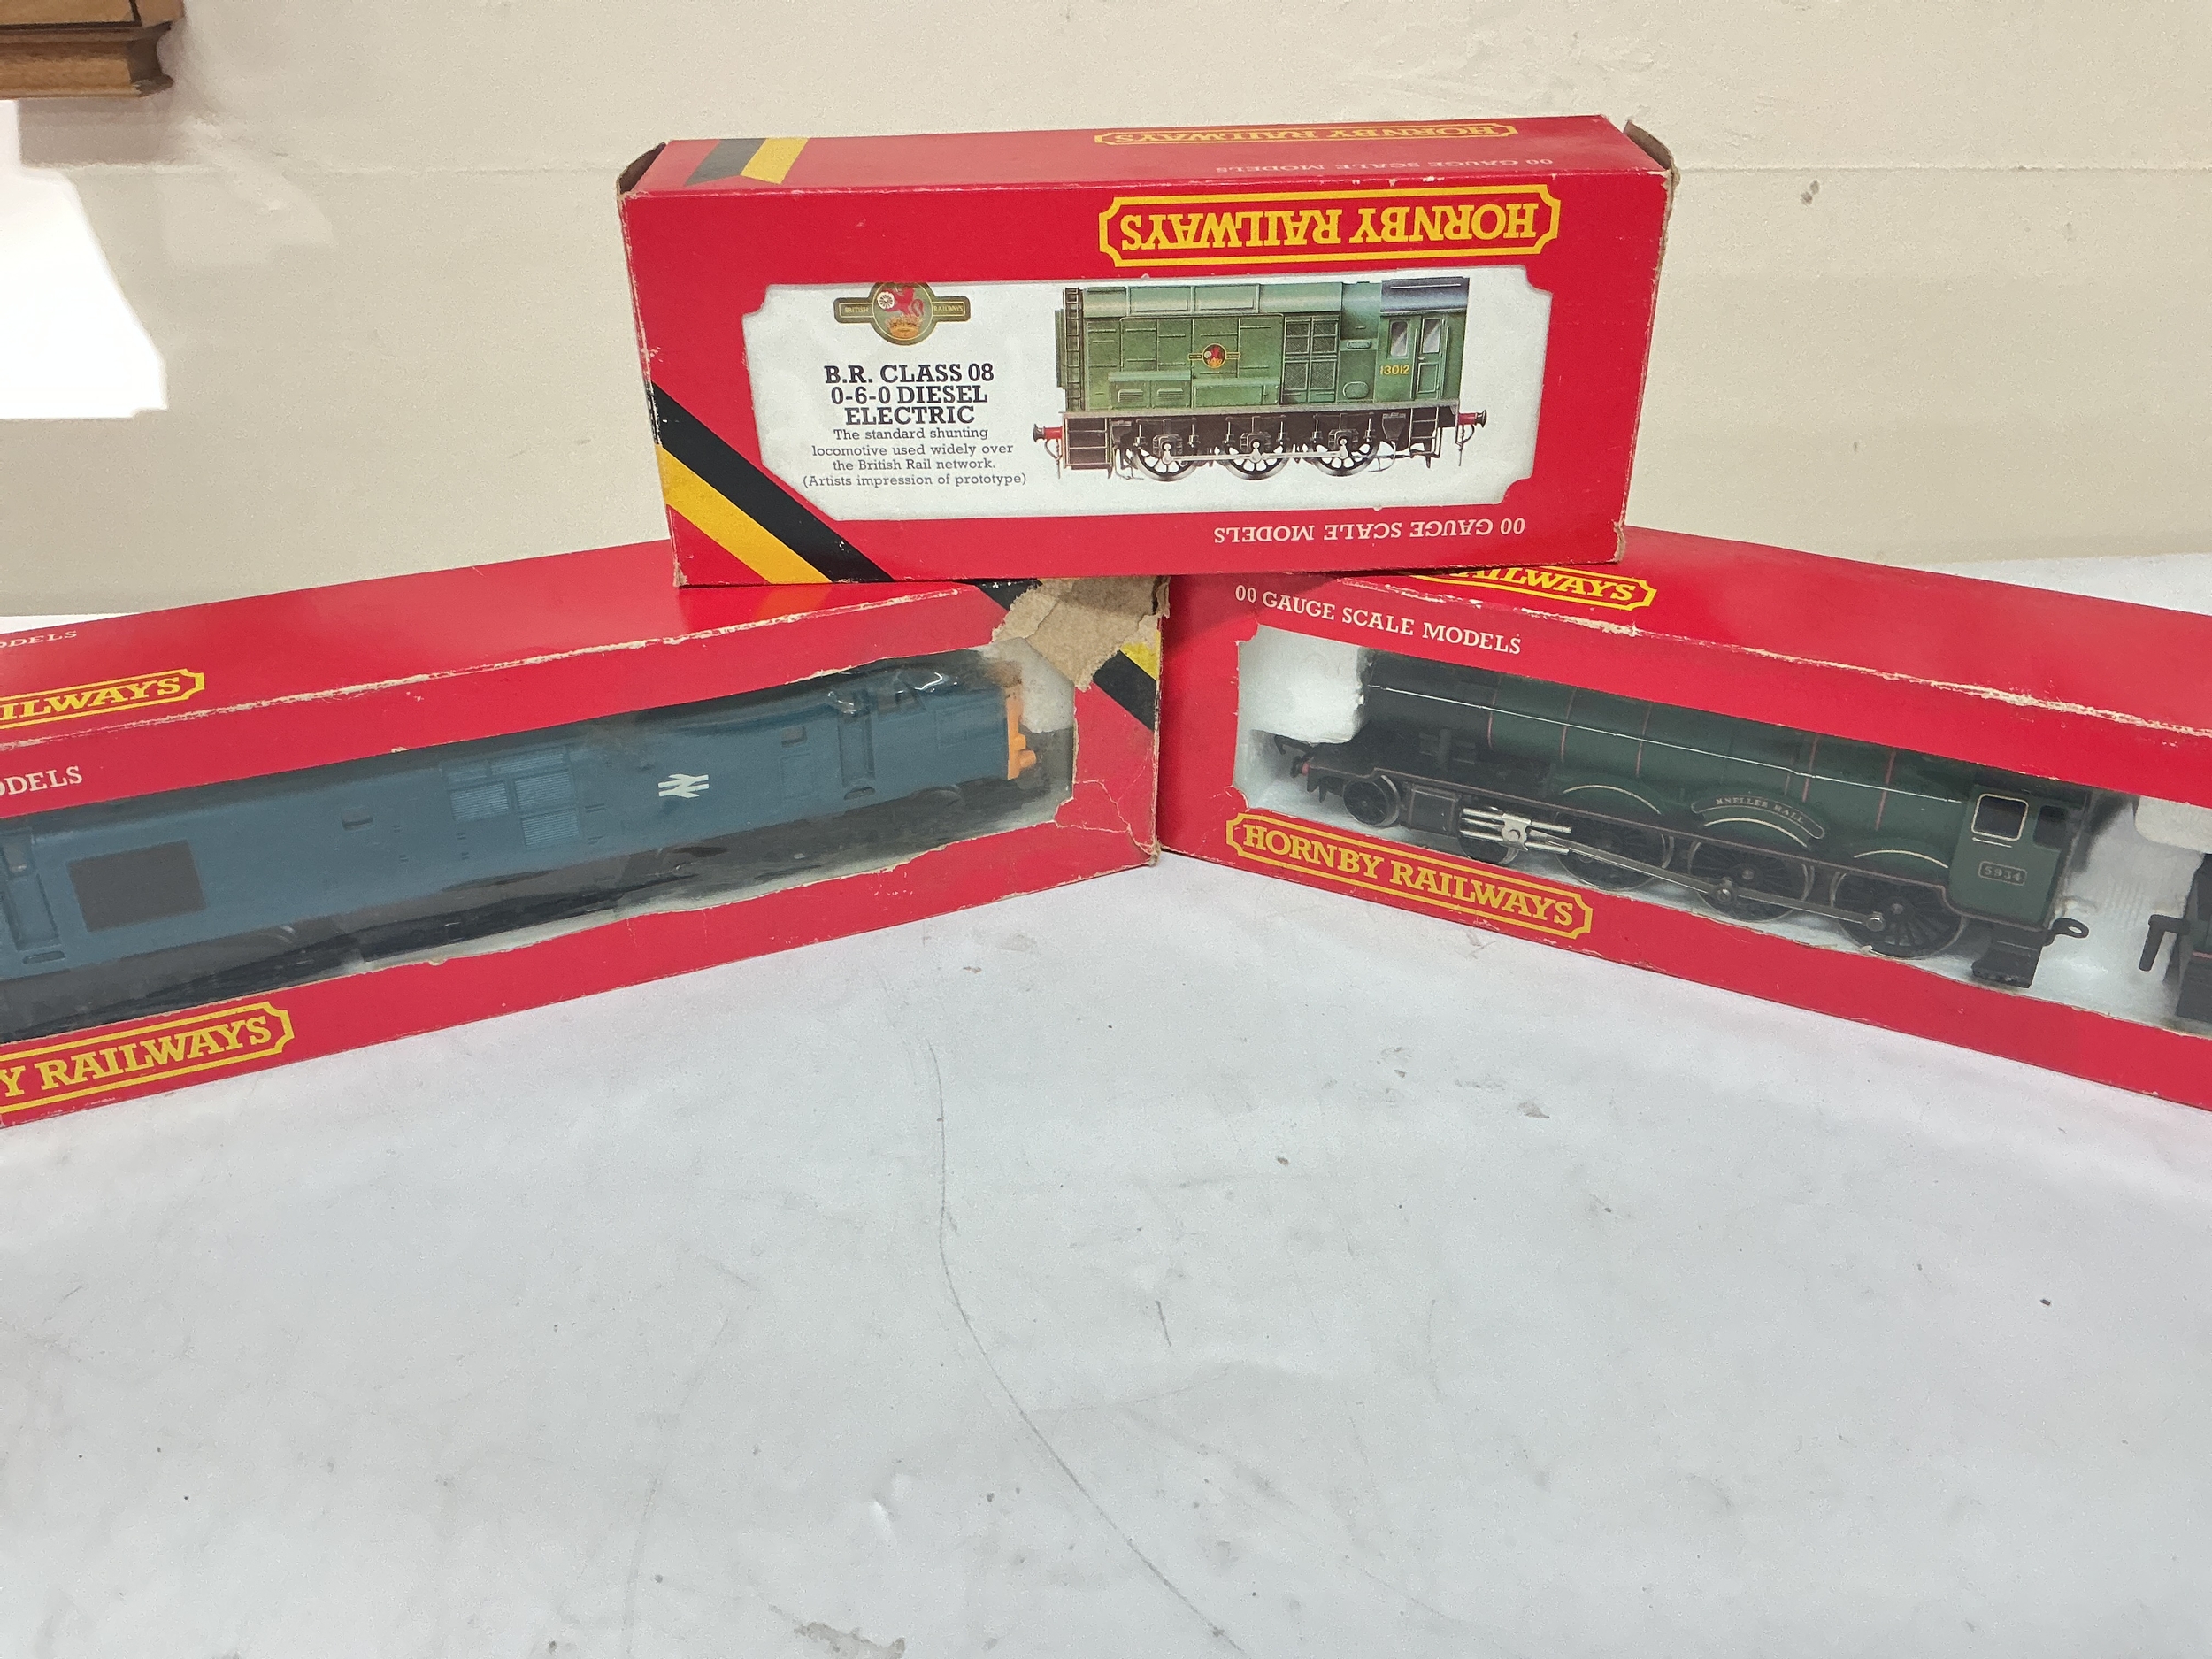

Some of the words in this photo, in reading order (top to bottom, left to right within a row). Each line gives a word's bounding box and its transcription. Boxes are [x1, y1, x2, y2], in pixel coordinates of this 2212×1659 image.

[1115, 130, 1317, 143] RAILWAYS
[1326, 125, 1501, 138] HORNBY
[1216, 164, 1325, 173] MODELS
[1121, 207, 1343, 251] RAILWAYS
[1348, 202, 1539, 244] HORNBY
[824, 365, 874, 384] B.R.
[879, 363, 963, 382] CLASS
[967, 362, 995, 381] 08
[1380, 365, 1410, 375] 13012
[830, 386, 891, 404] 0-6-0
[895, 384, 988, 404] DIESEL
[844, 405, 975, 425] ELECTRIC
[833, 428, 861, 440] The
[864, 426, 926, 439] standard
[929, 426, 989, 440] shunting
[811, 445, 887, 457] locomotive
[892, 444, 926, 456] used
[930, 442, 977, 458] widely
[981, 443, 1014, 454] over
[832, 458, 855, 471] the
[858, 458, 902, 470] British
[905, 457, 932, 470] Rail
[936, 457, 996, 470] network.
[803, 474, 853, 488] (Artists
[856, 473, 933, 488] impression
[936, 472, 953, 485] of
[955, 472, 1027, 487] prototype)
[1214, 524, 1314, 543] MODELS
[1324, 521, 1402, 540] SCALE
[1409, 518, 1494, 538] GAUGE
[1449, 567, 1637, 601] ILWAYS
[1262, 590, 1336, 621] GAUGE
[1341, 606, 1415, 636] SCALE
[1422, 621, 1522, 655] MODELS
[0, 676, 181, 721] ILWAYS
[0, 765, 83, 796] DELS
[1242, 823, 1385, 879] HORNBY
[1389, 858, 1574, 926] RAILWAYS
[34, 1015, 272, 1090] RAILWAYS
